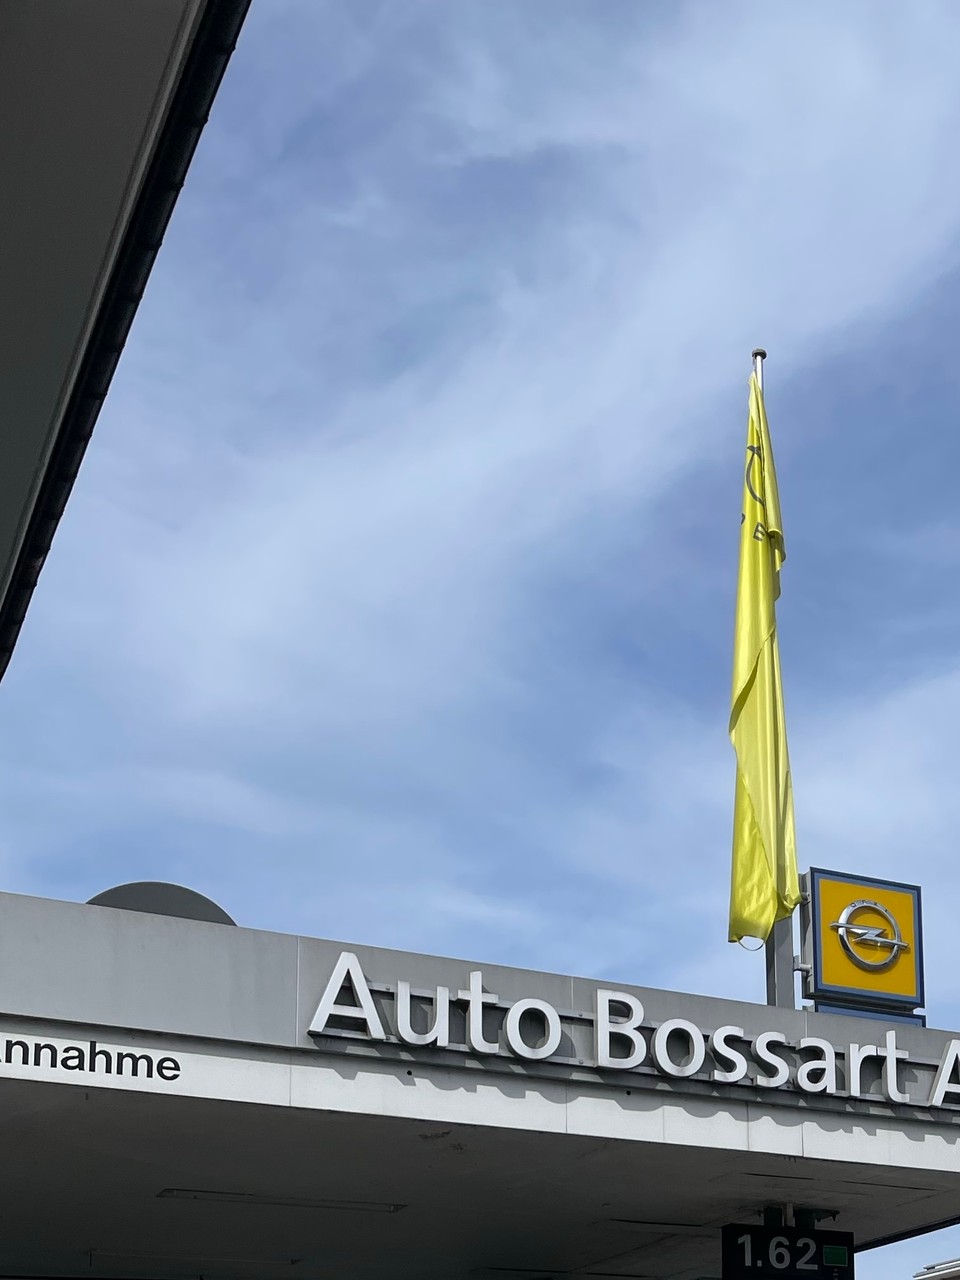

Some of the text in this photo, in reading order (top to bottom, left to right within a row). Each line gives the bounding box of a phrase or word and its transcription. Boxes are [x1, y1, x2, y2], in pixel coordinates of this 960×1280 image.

[308, 951, 562, 1060] Auto
[594, 987, 910, 1103] Bossart
[0, 1040, 181, 1081] nnahme
[737, 1234, 818, 1270] 1.62
